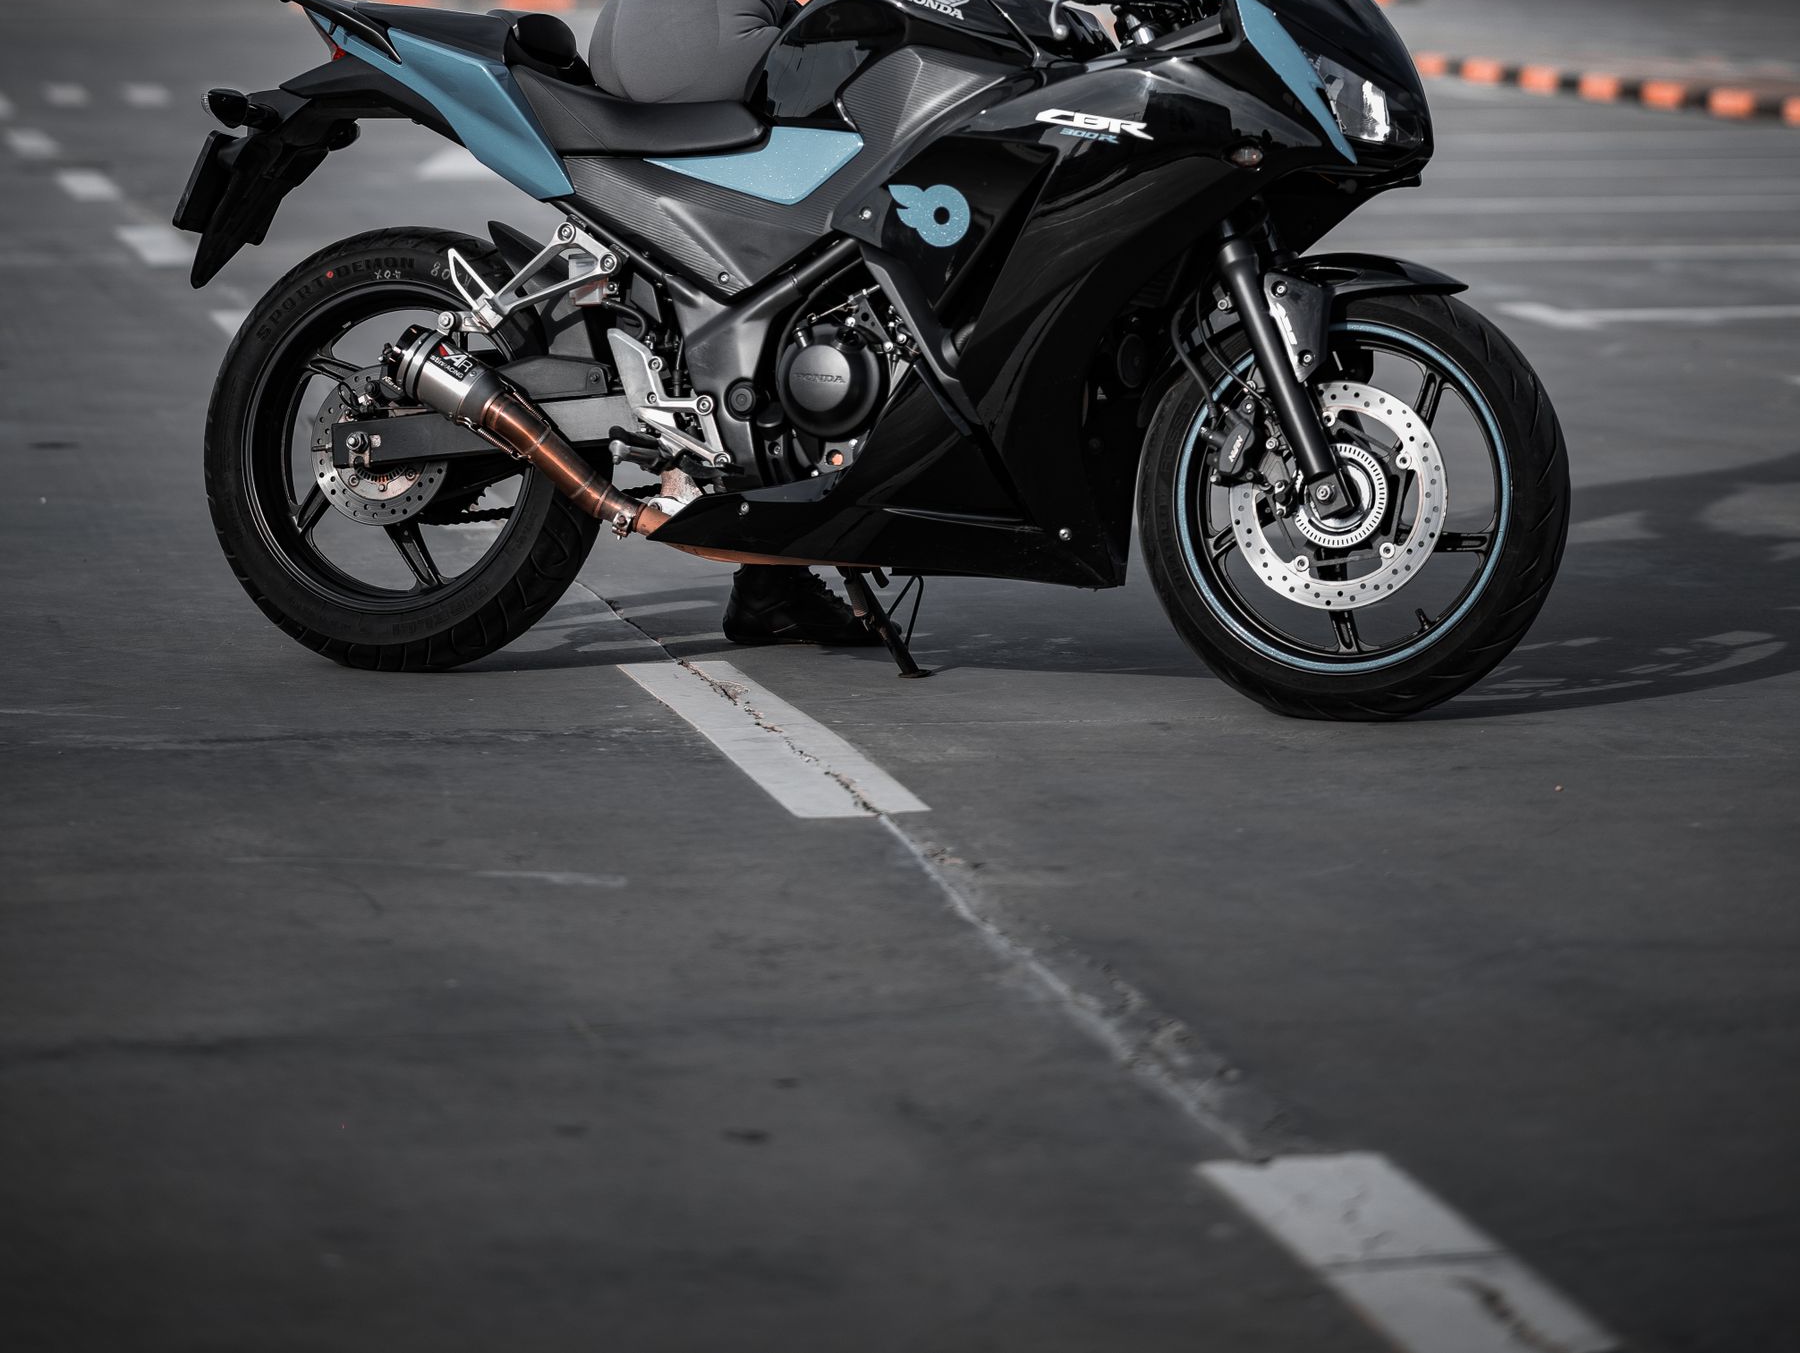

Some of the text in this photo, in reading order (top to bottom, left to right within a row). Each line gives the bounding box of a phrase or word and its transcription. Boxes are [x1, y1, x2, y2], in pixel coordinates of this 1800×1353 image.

[1035, 108, 1154, 141] CBR
[255, 256, 415, 342] SPORT DEMON
[792, 372, 846, 384] HONDA
